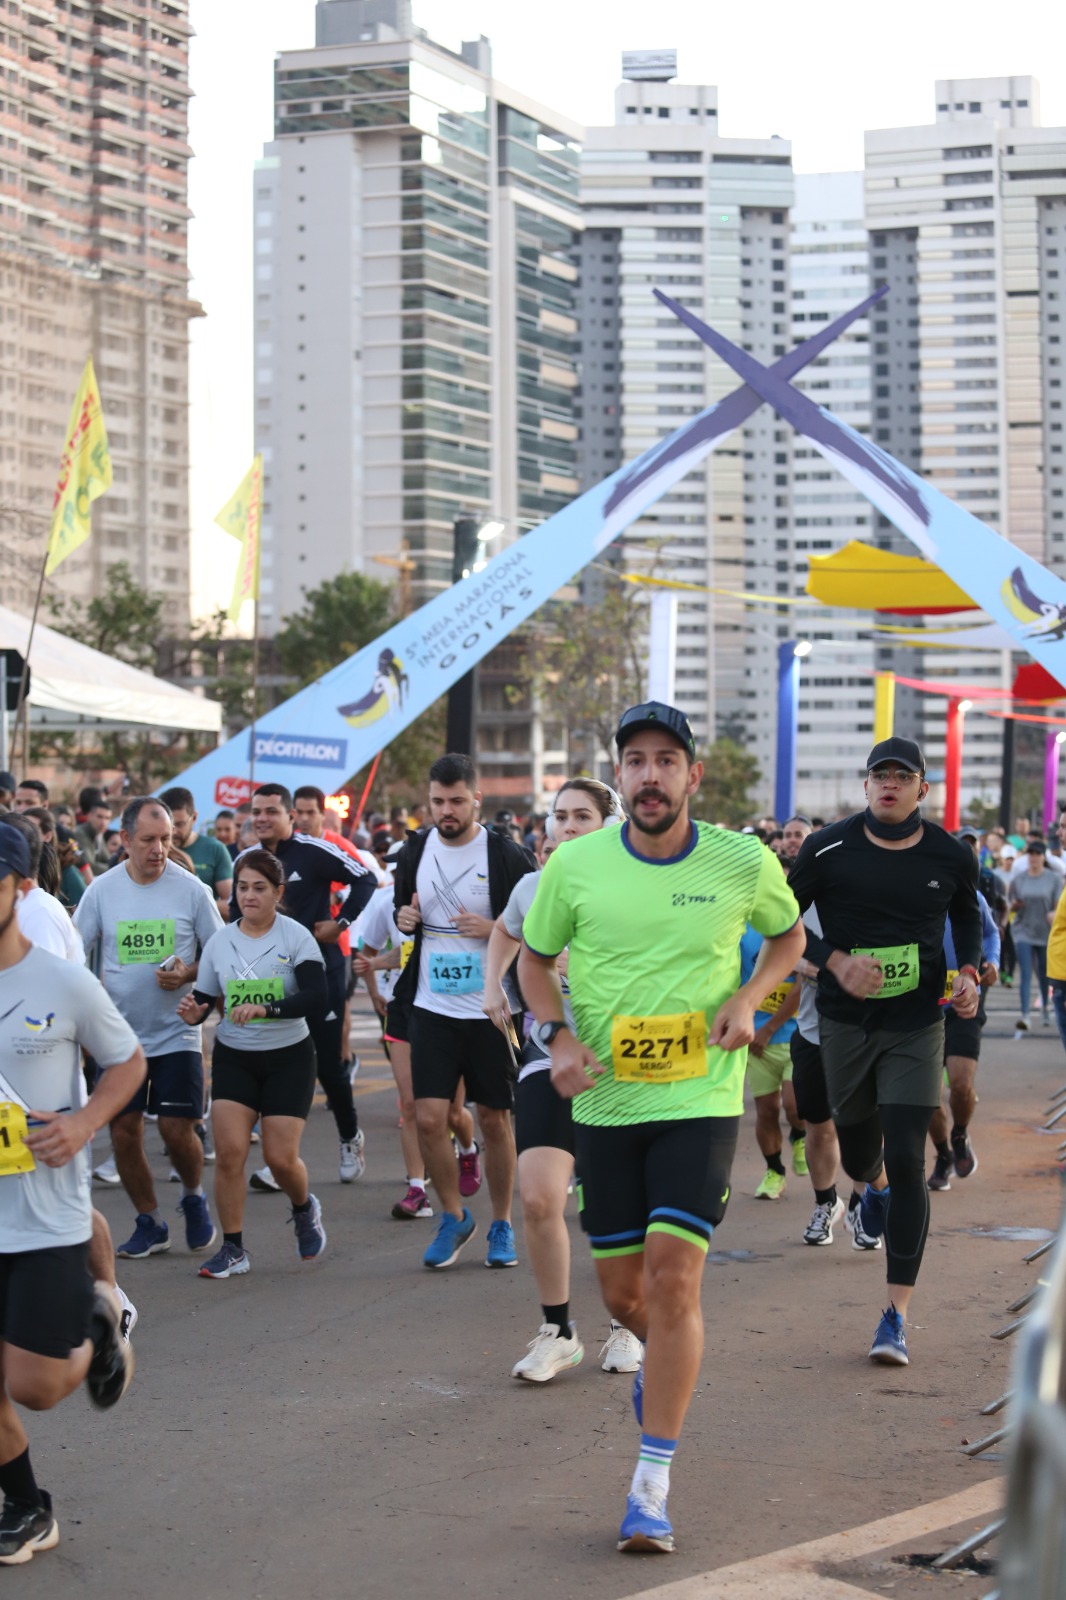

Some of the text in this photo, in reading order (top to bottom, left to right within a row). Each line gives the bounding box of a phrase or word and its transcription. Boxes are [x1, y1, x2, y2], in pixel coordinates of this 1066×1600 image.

[421, 616, 453, 646] MEIA
[454, 552, 527, 617] MARATONA
[418, 567, 533, 668] INTERNACIONAL
[122, 933, 165, 948] 4891
[433, 966, 473, 980] 1437
[620, 1035, 689, 1058] 2271
